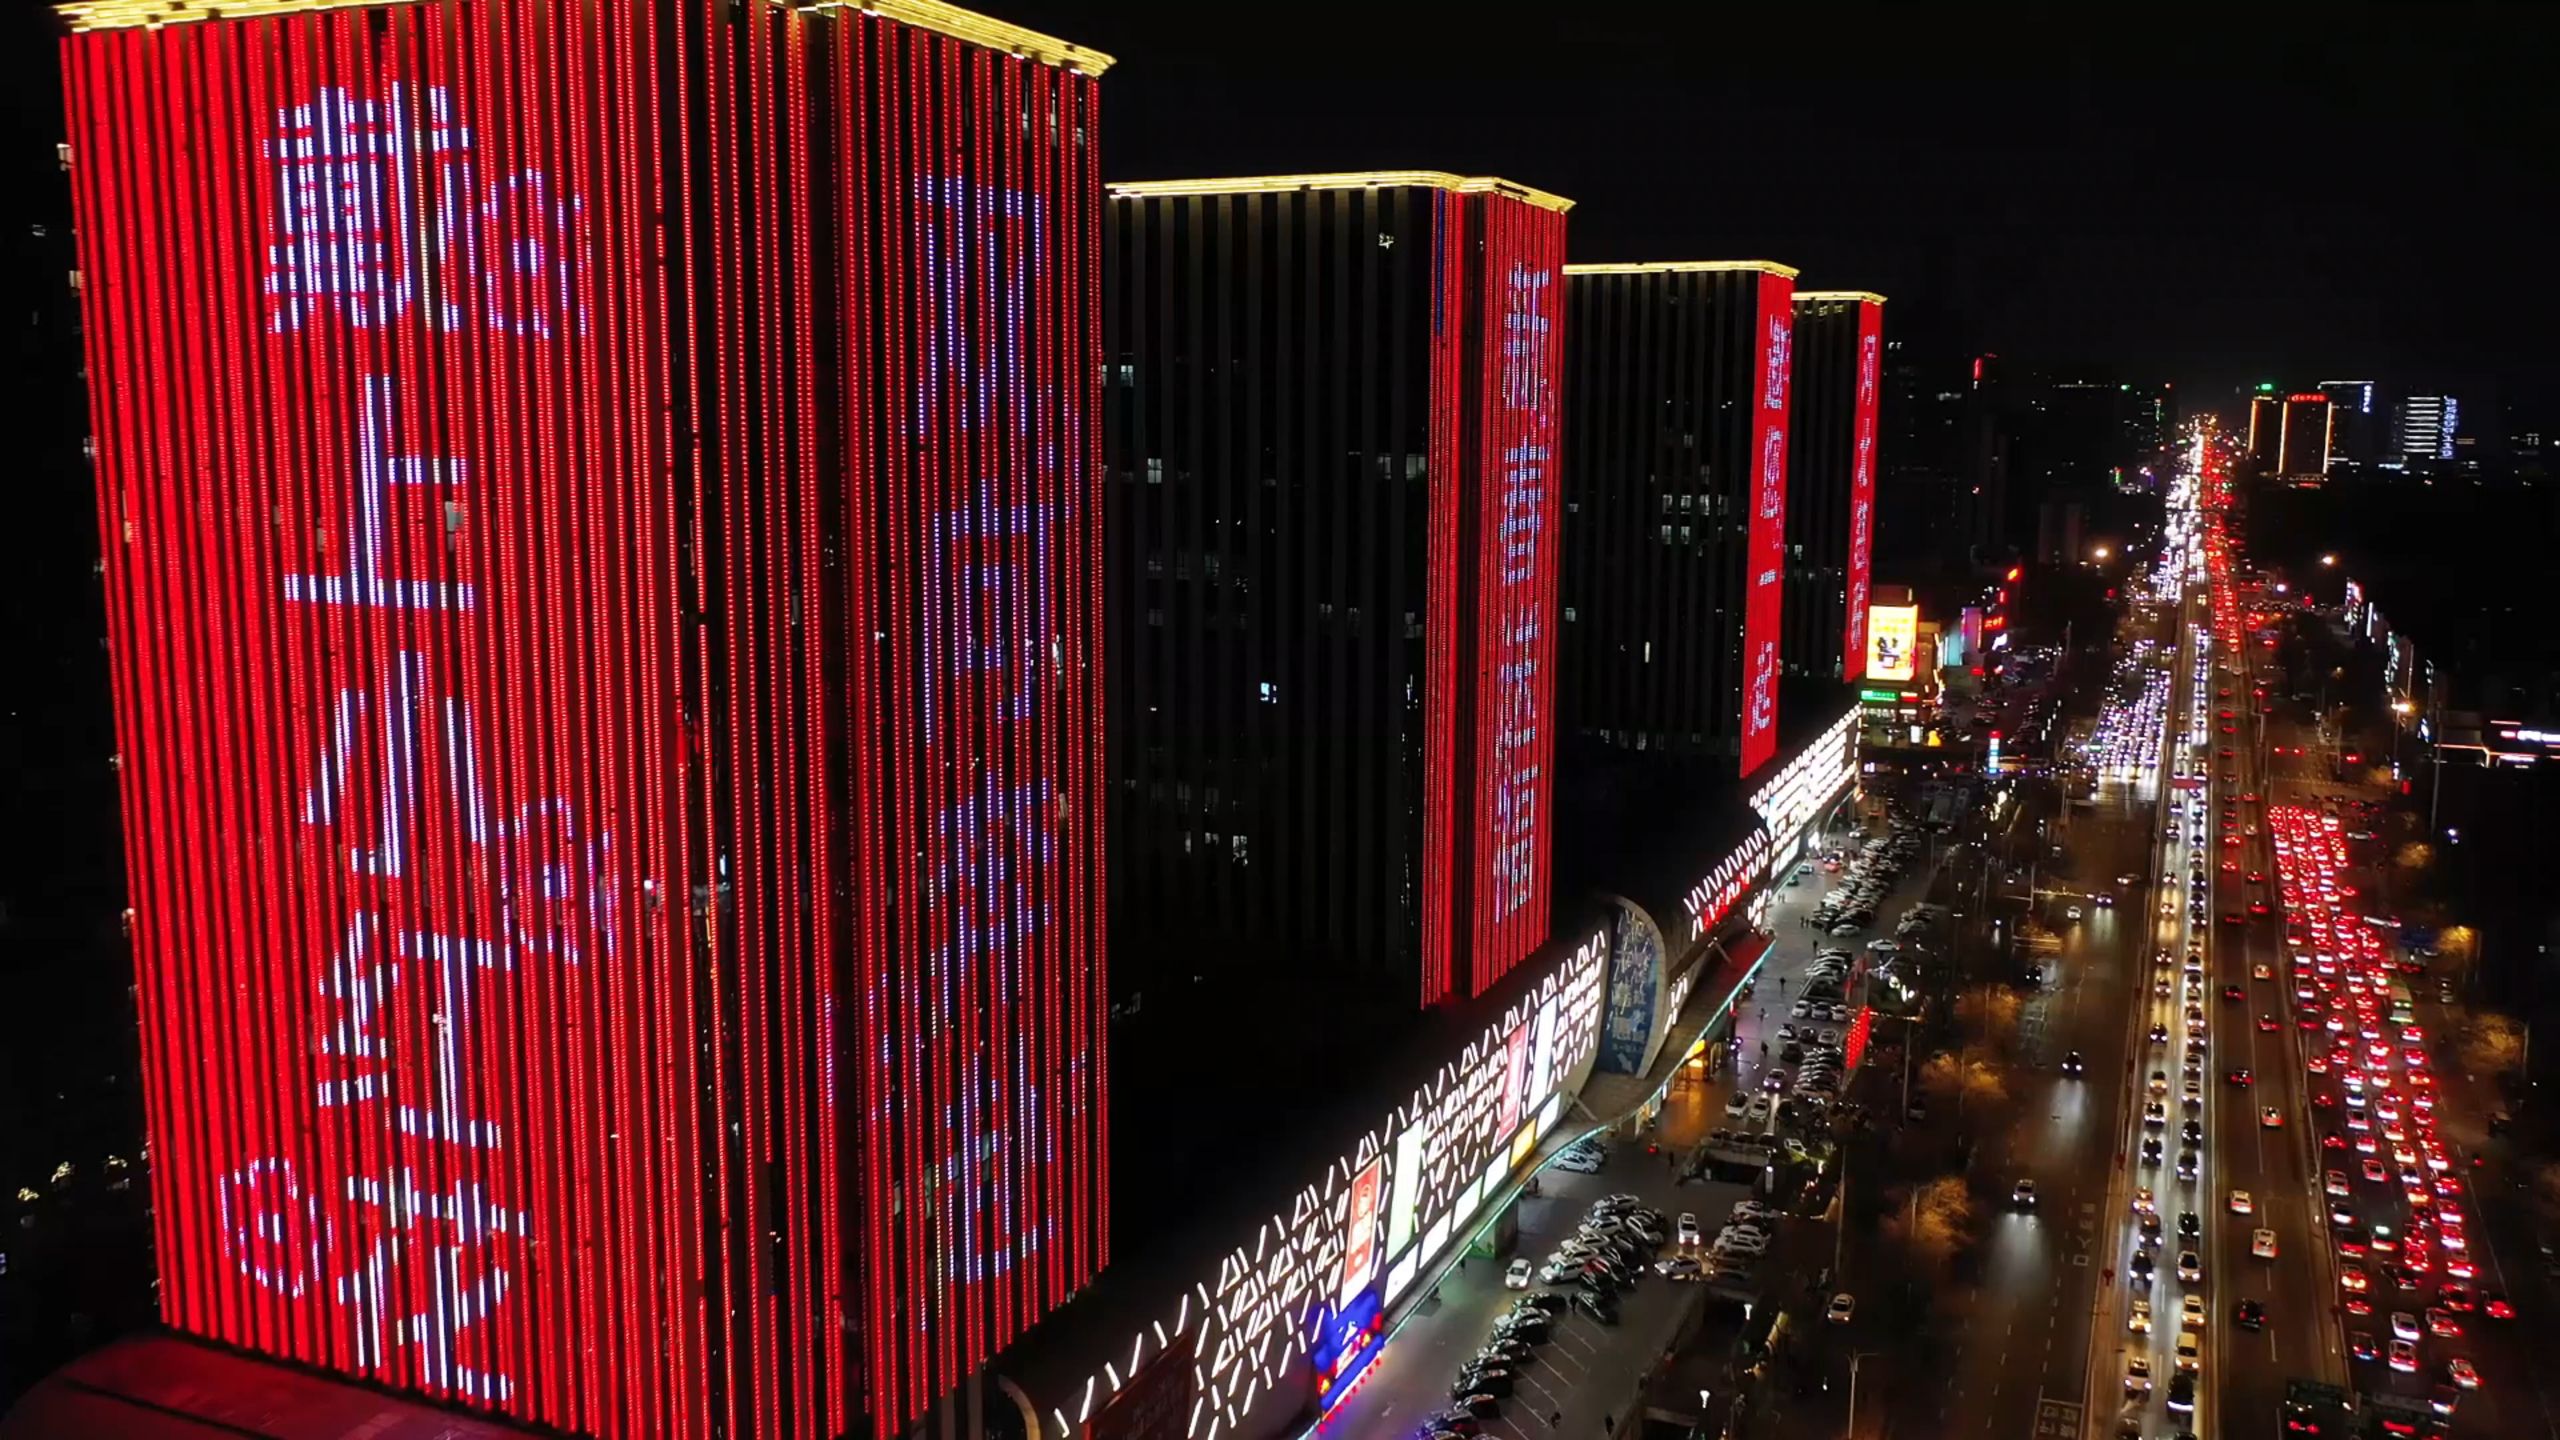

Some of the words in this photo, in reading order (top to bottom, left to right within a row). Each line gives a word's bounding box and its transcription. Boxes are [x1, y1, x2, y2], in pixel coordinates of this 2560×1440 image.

[266, 80, 529, 1402] 戴上小红花
[914, 173, 1050, 1282] 双向奔赴
